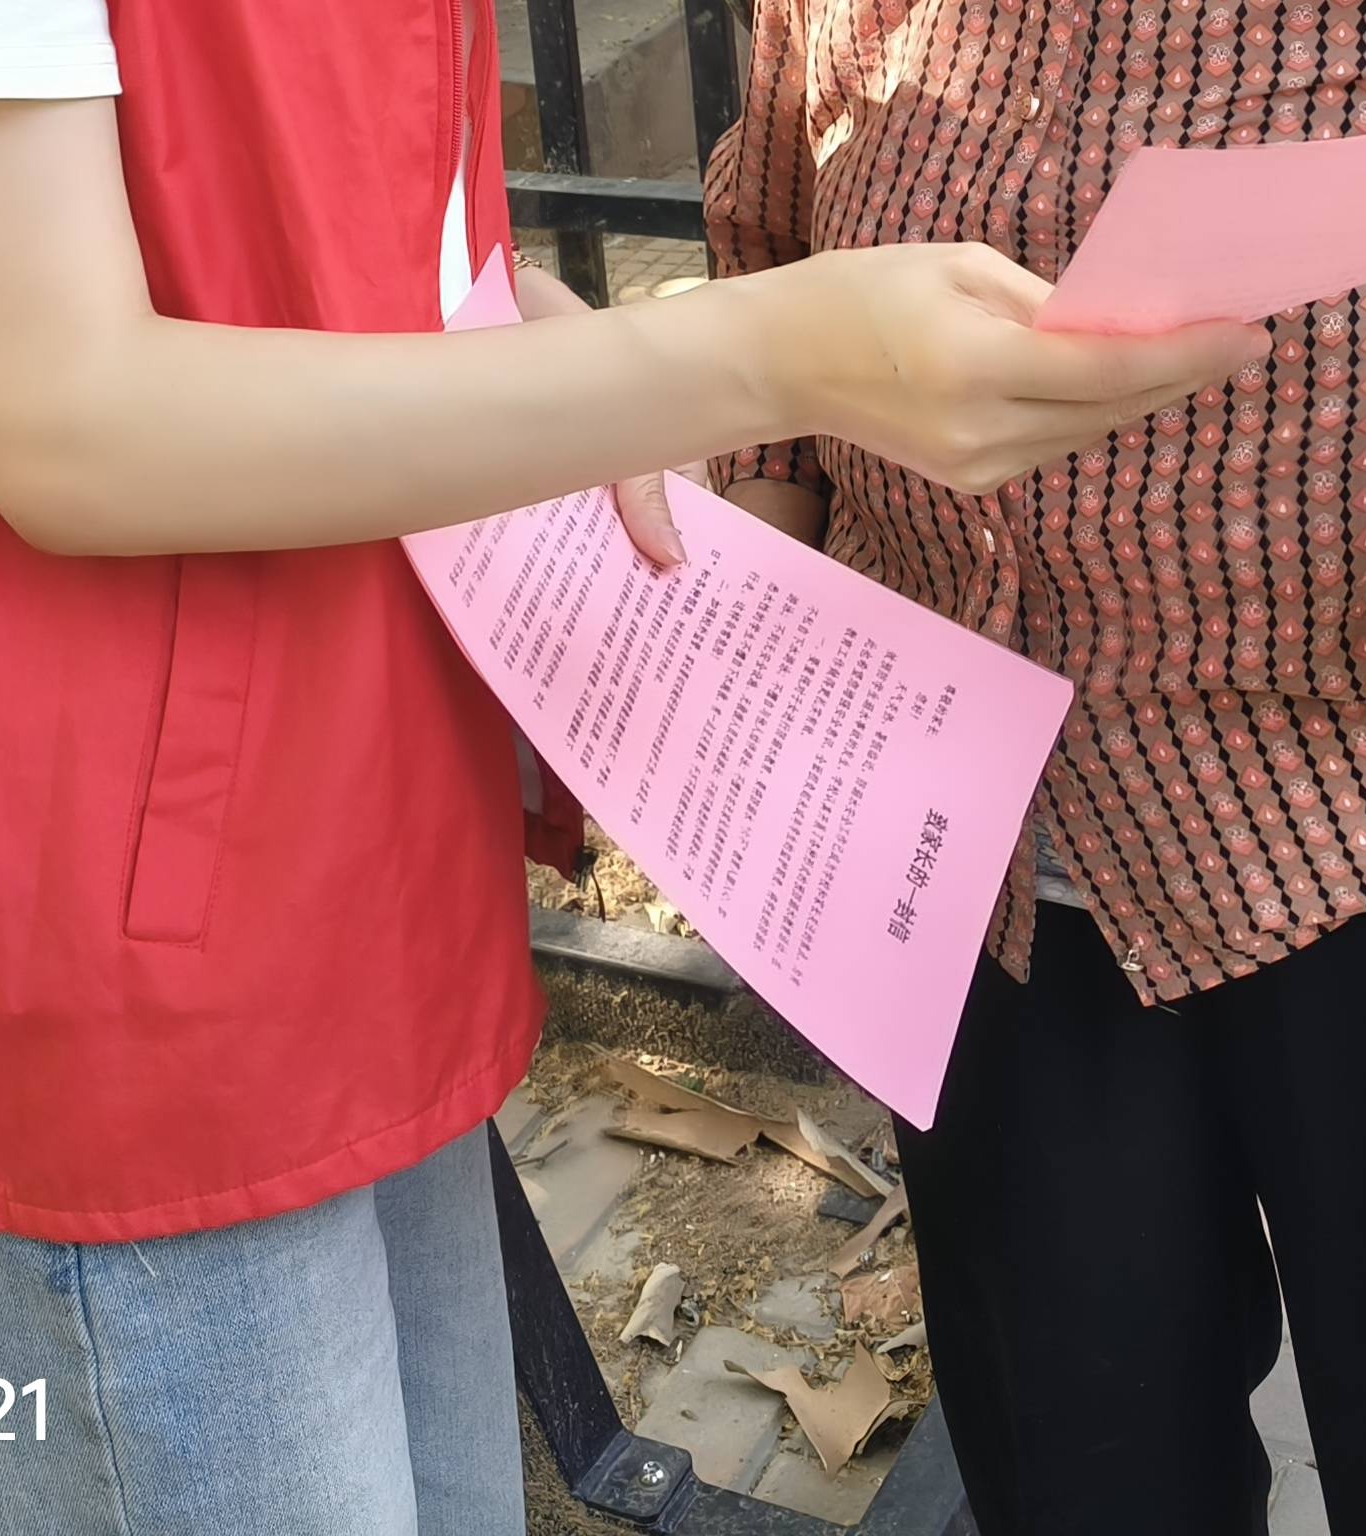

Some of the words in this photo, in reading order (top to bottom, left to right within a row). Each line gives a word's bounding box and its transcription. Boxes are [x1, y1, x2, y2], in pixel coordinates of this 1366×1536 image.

[883, 806, 951, 945] 致家长的一封信
